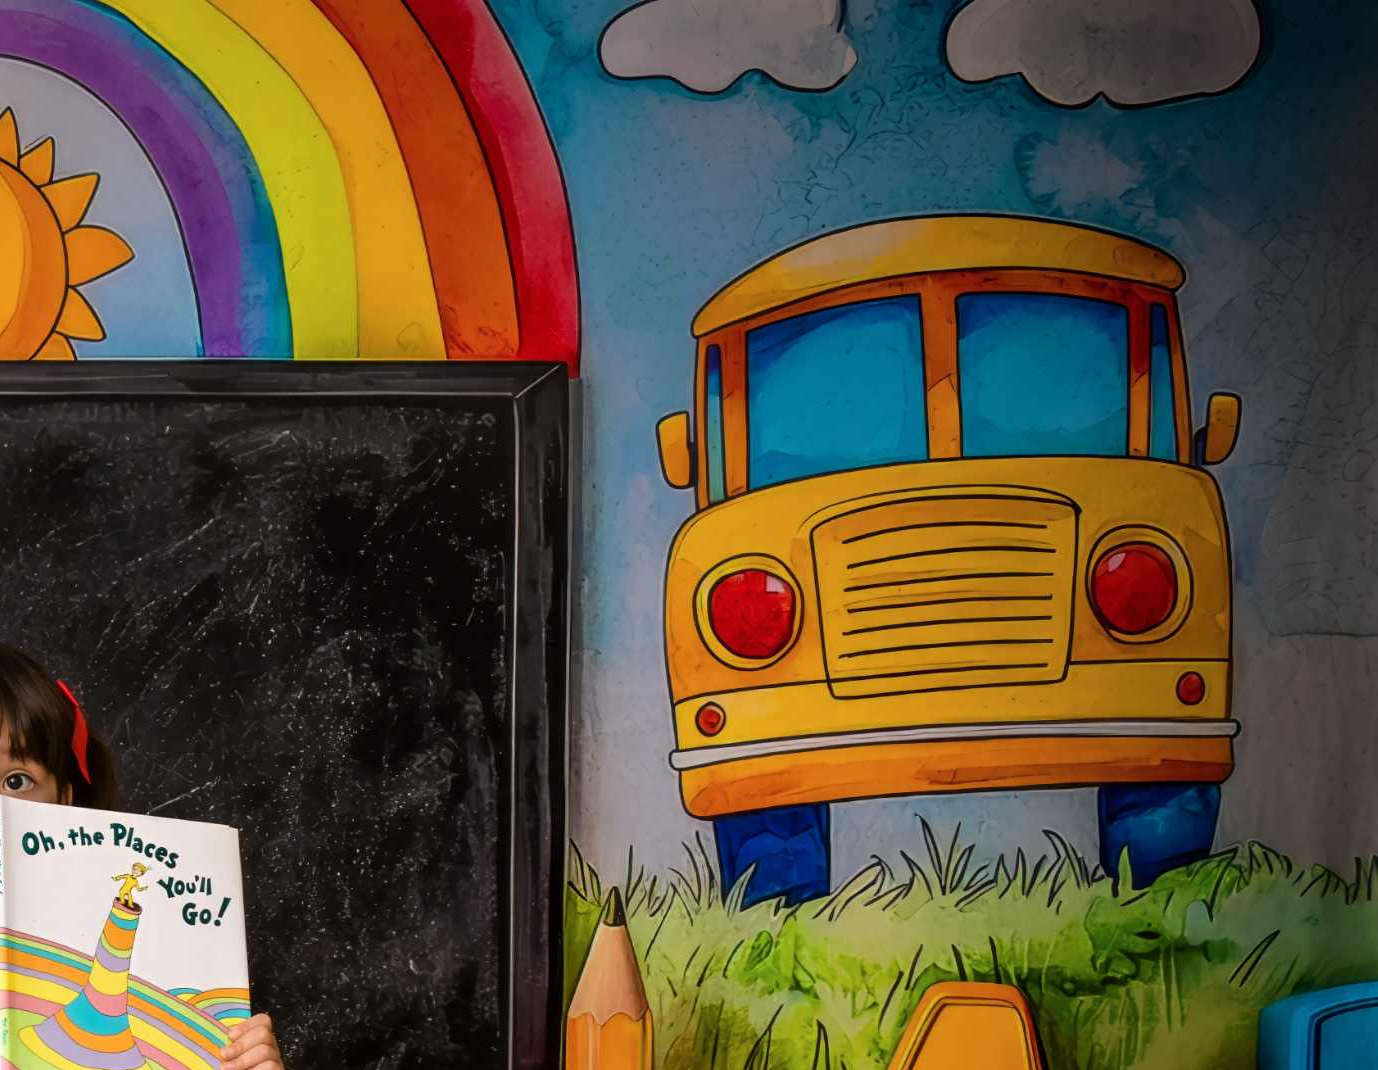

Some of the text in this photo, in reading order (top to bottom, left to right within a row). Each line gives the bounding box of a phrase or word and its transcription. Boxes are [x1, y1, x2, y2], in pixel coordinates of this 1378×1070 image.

[22, 822, 179, 869] Oh, the Places
[157, 875, 212, 898] You'll
[182, 897, 231, 926] Go!
